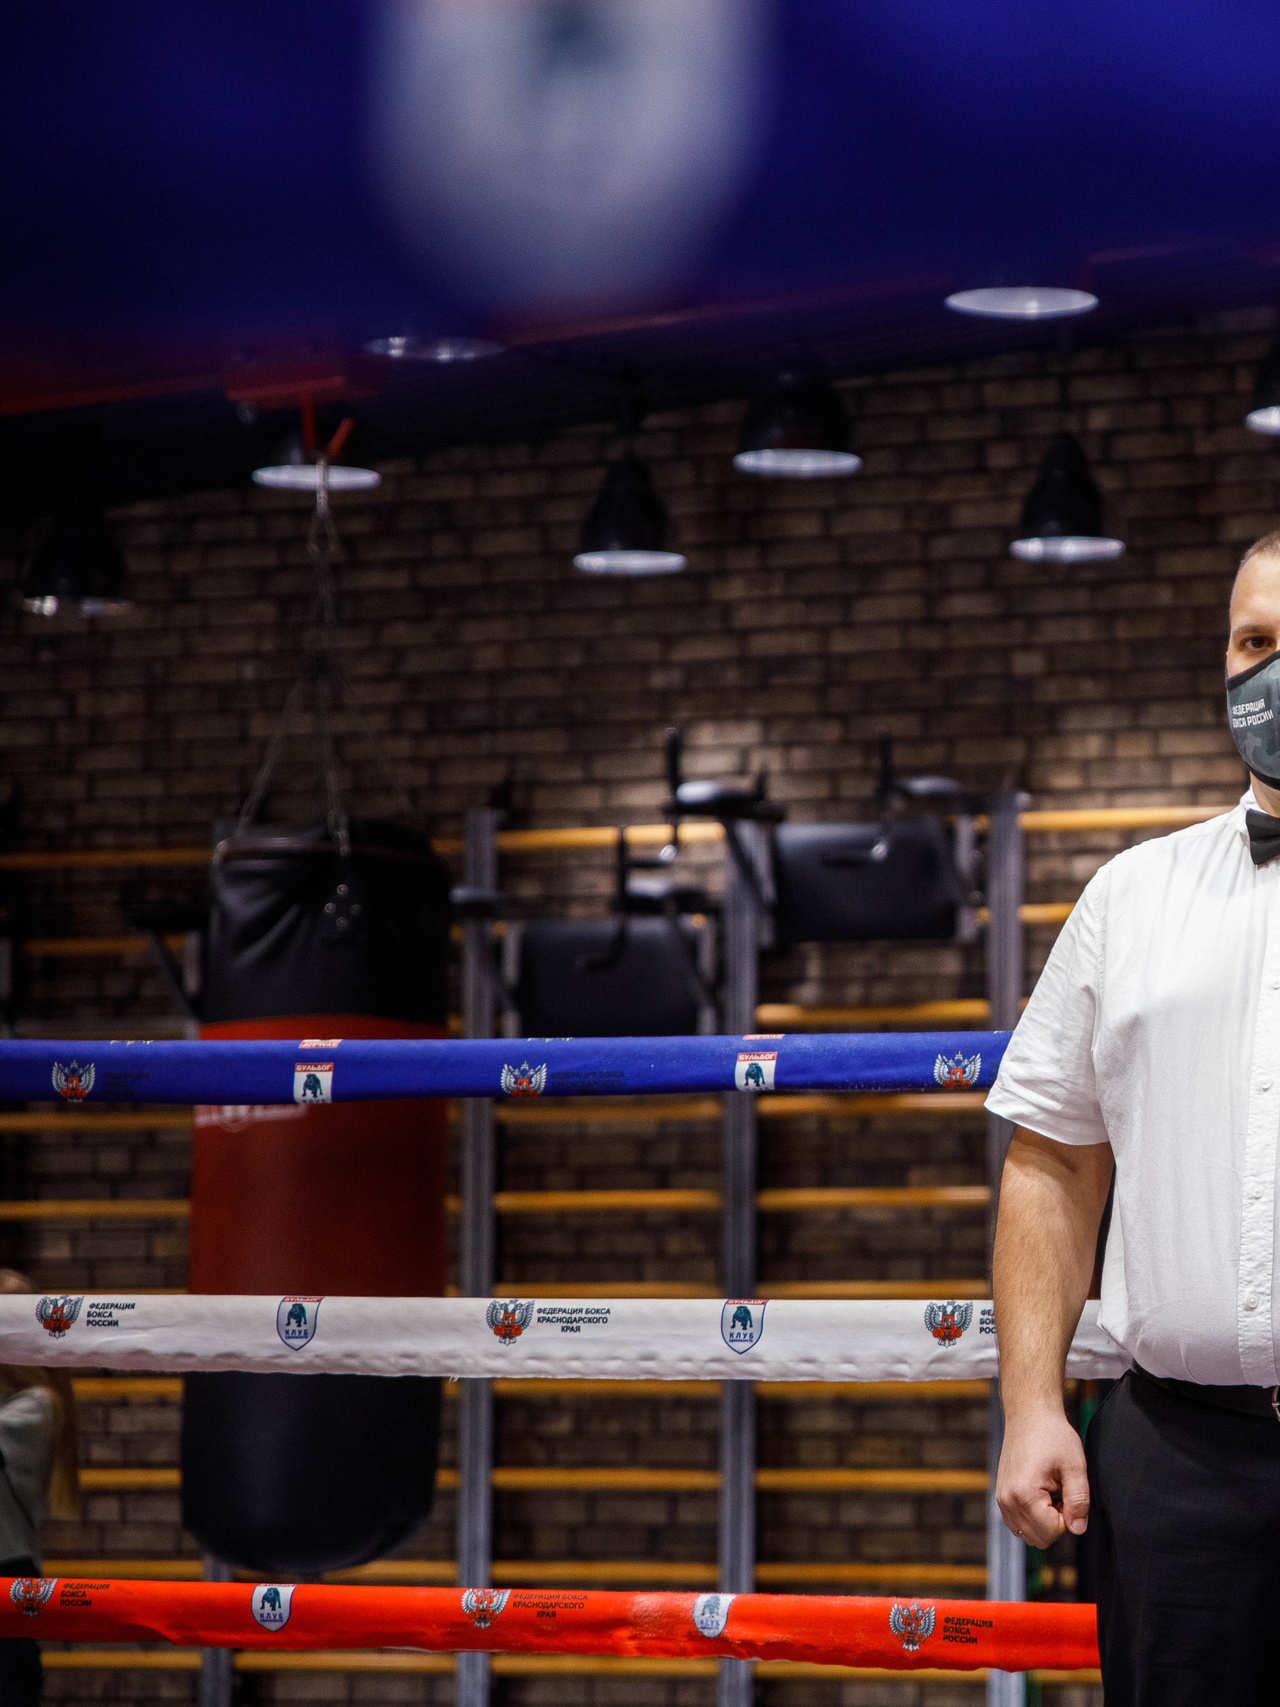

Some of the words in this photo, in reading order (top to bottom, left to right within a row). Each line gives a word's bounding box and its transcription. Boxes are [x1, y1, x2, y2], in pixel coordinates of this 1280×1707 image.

[1247, 709, 1274, 726] РОССИИ
[739, 1053, 776, 1061] БУЛЬДОГ
[89, 1302, 136, 1310] ФЕДЕРАЦИЯ
[537, 1307, 583, 1315] ФЕДЕРАЦИЯ
[86, 1319, 119, 1327] РОССИИ
[537, 1316, 608, 1324] КРАСНОДАРСКОГО
[285, 1328, 309, 1336] КЛУБ
[560, 1325, 581, 1333] КРАЯ
[60, 1590, 87, 1598] БОКСА
[512, 1601, 585, 1609] КРАСНОДАРСКОГО
[944, 1616, 993, 1627] ФЕДЕРАЦИЯ
[943, 1626, 970, 1635] БОКСА
[942, 1635, 978, 1644] РОССИИ
